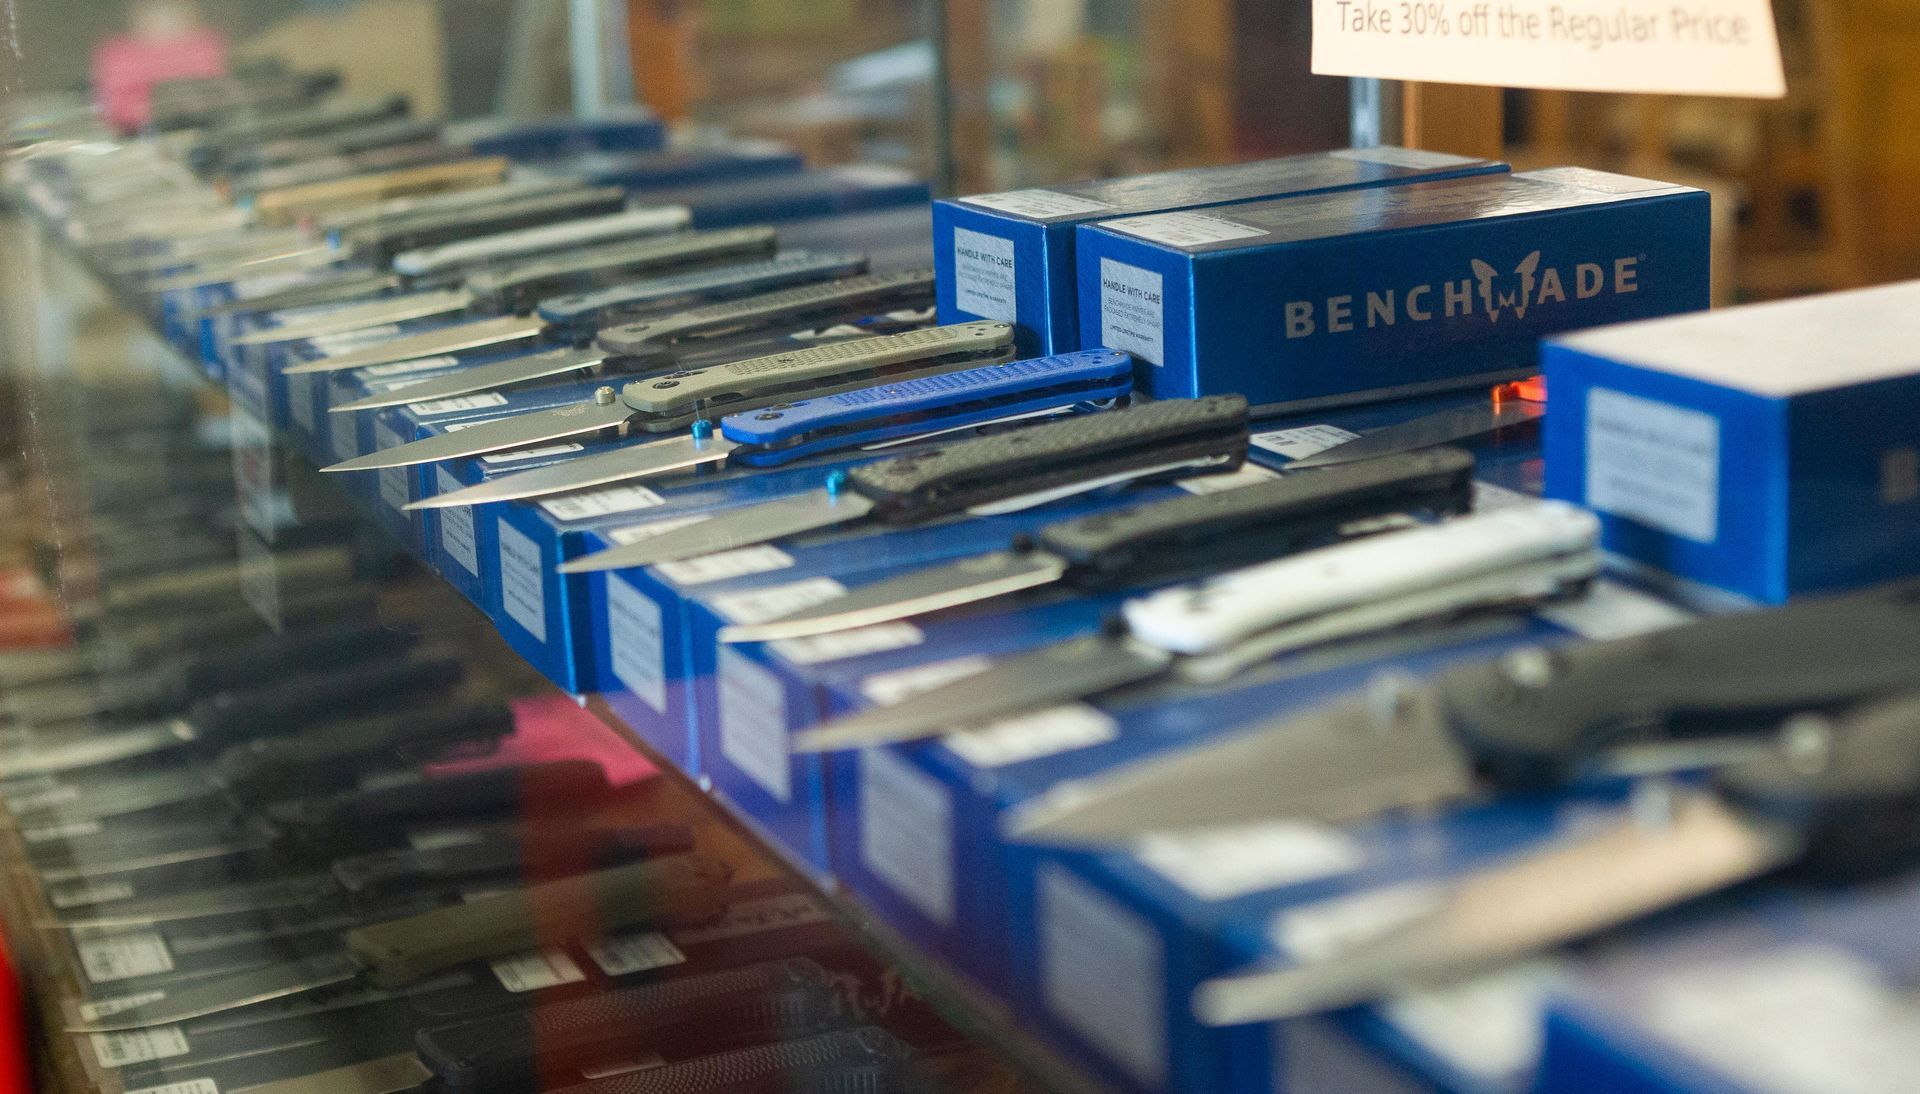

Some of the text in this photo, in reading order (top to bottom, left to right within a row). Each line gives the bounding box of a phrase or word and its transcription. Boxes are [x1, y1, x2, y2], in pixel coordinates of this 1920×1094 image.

[1336, 0, 1750, 50] Take 30% off the Regular Price
[957, 247, 1012, 268] HANDLE WITH CARE
[1103, 279, 1160, 304] HANDLE WITH CARE
